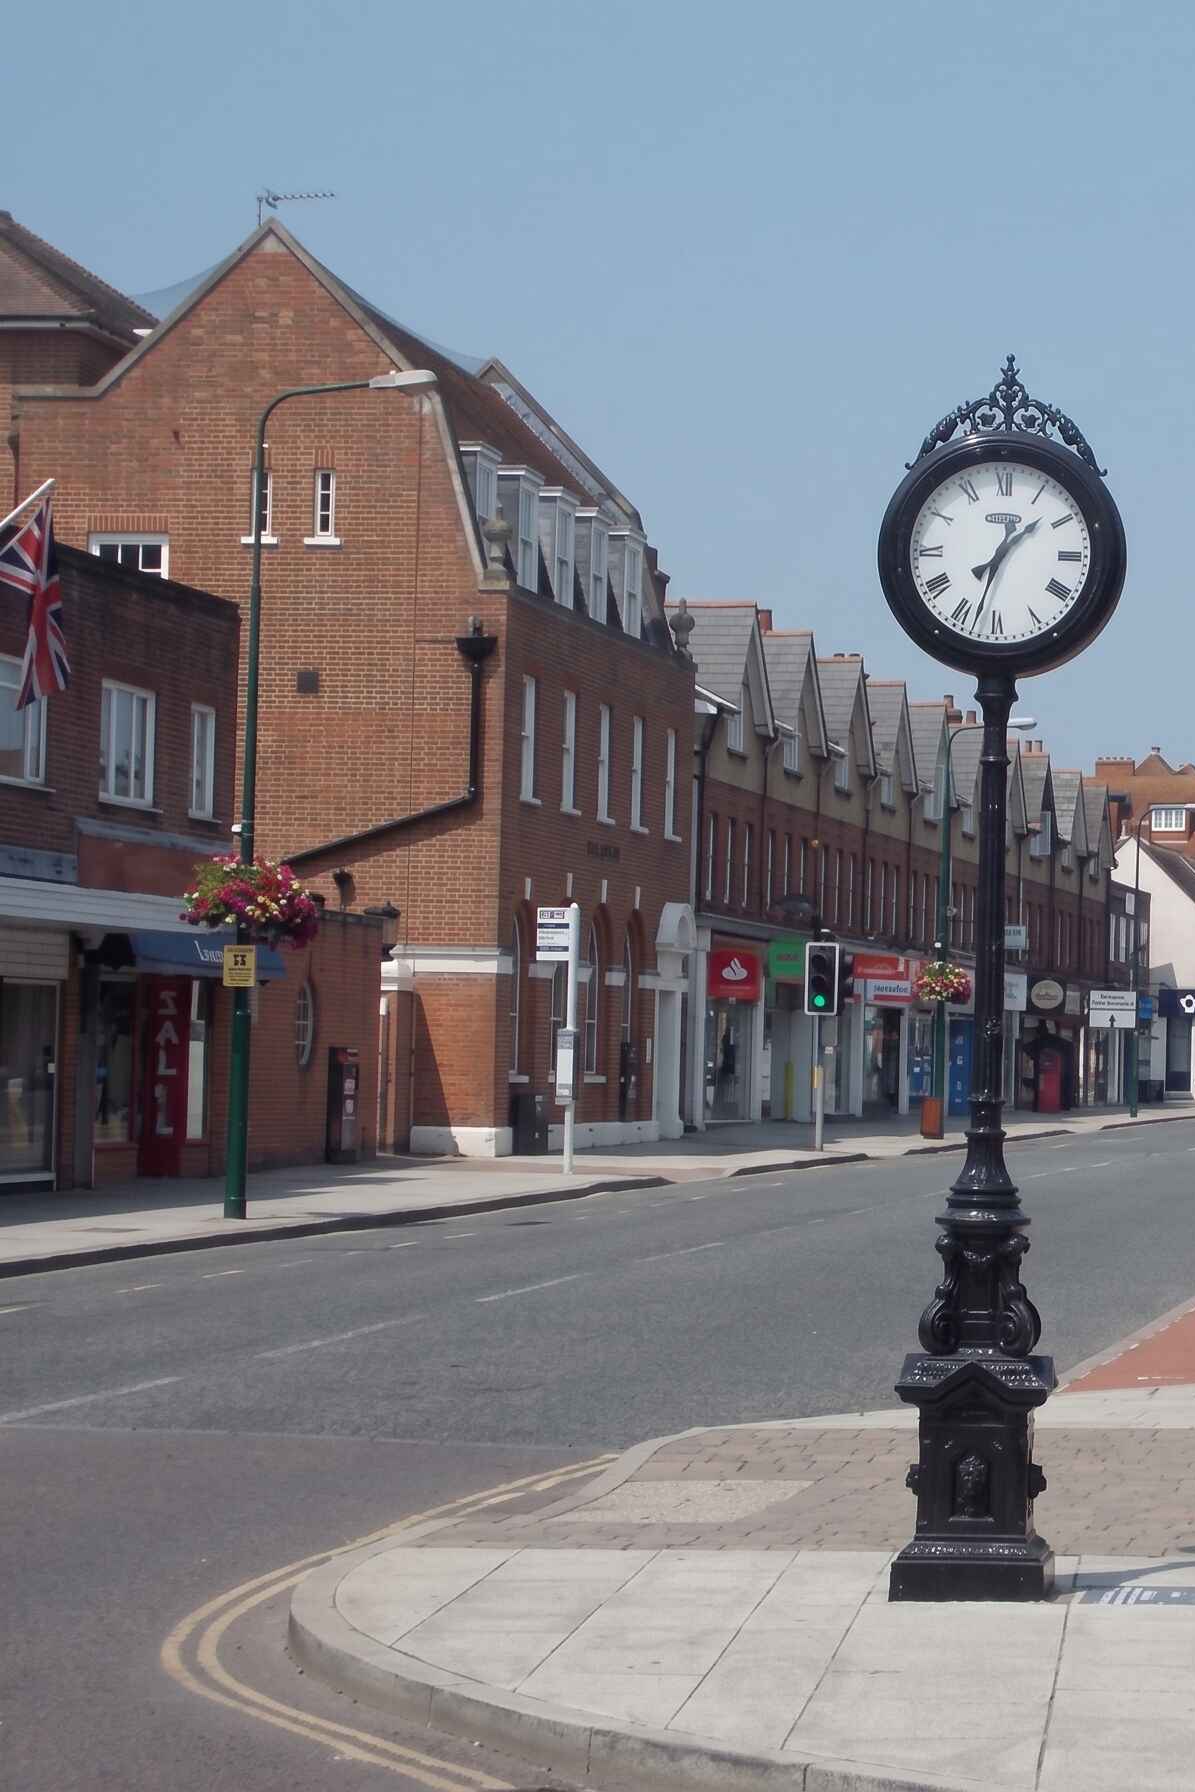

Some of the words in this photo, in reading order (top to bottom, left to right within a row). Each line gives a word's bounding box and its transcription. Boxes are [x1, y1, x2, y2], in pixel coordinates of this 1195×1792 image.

[995, 472, 1013, 497] XII
[1031, 484, 1046, 505] I
[931, 511, 954, 526] X
[1051, 513, 1074, 529] II
[1057, 550, 1082, 562] III
[1044, 577, 1073, 601] IIII
[991, 610, 1004, 635] VI
[1027, 606, 1042, 626] V
